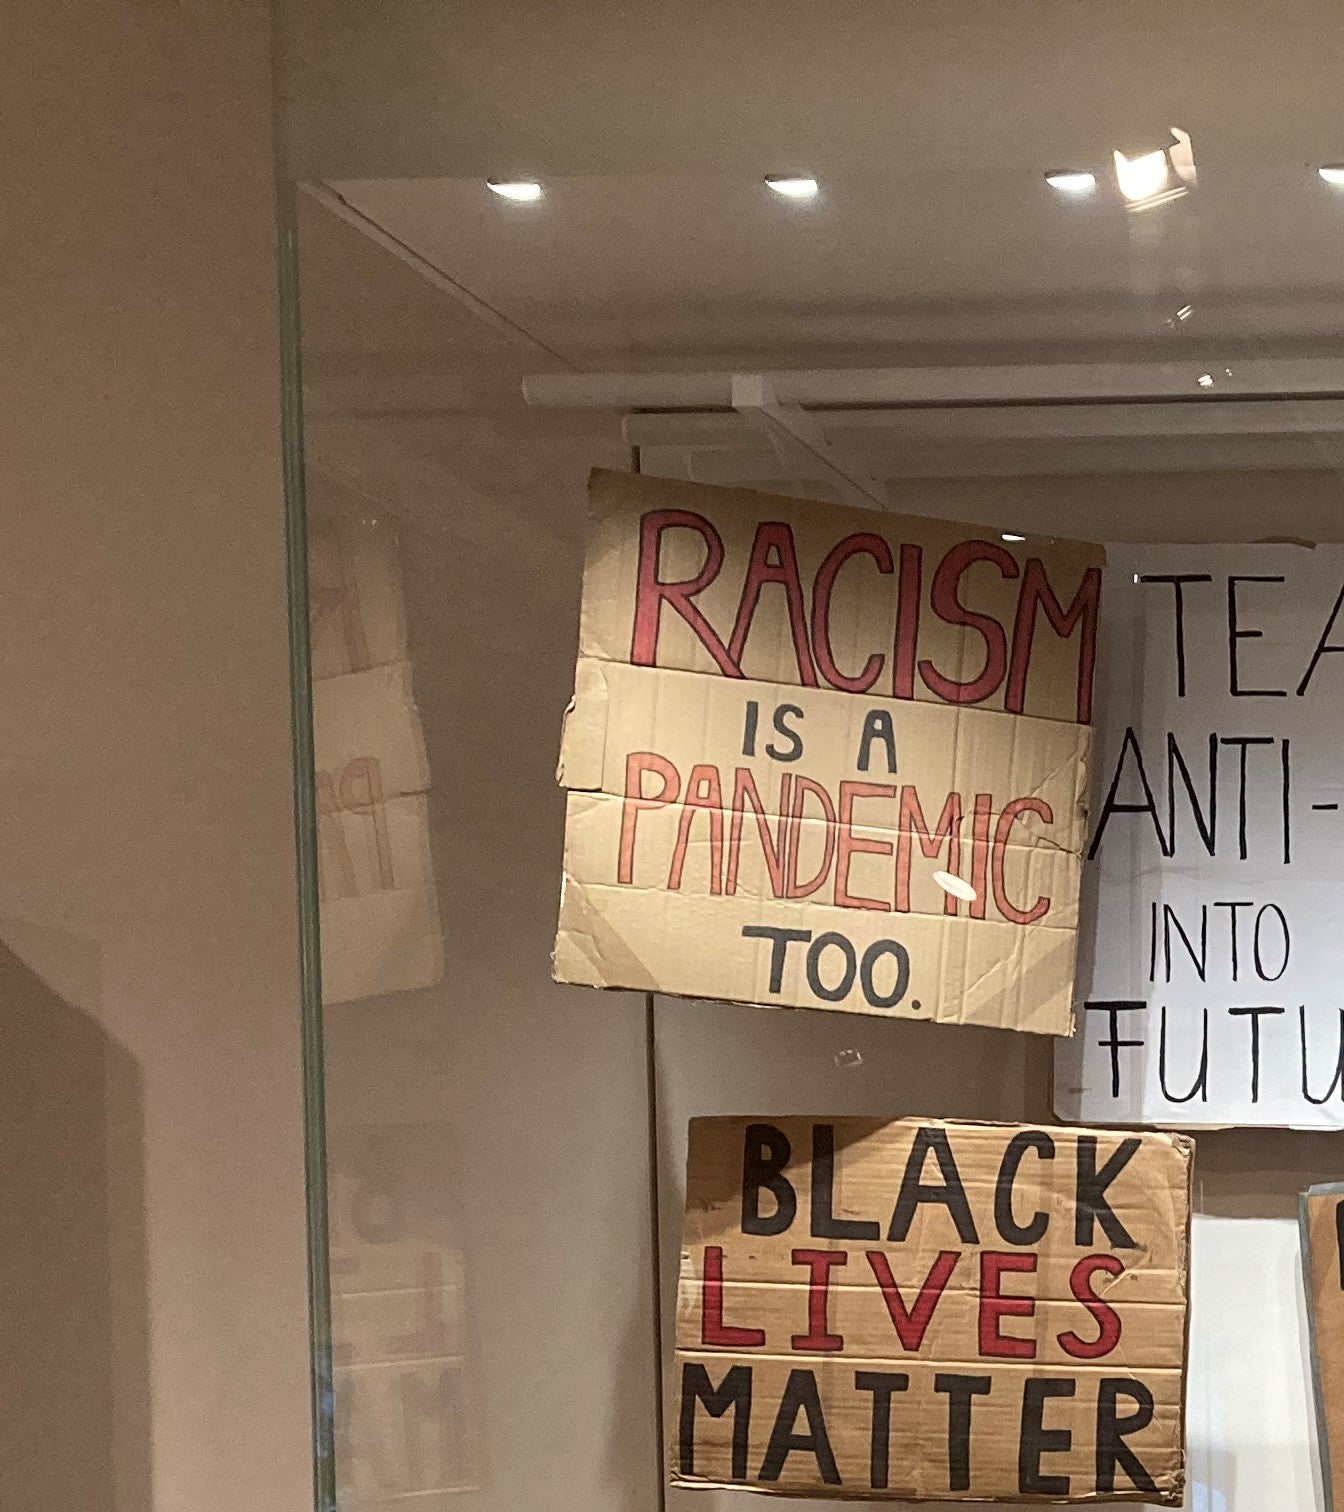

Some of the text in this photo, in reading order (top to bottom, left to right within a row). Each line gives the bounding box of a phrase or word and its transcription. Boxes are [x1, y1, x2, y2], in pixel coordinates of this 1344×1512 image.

[630, 508, 1102, 724] RACISM
[742, 701, 897, 773] IS A
[617, 752, 1054, 924] PANDEMIC
[742, 925, 921, 1011] TOO.
[1150, 902, 1289, 982] INTO
[741, 1124, 1142, 1249] BLACK
[702, 1246, 1126, 1359] LIVES
[680, 1362, 1161, 1495] MATTER
